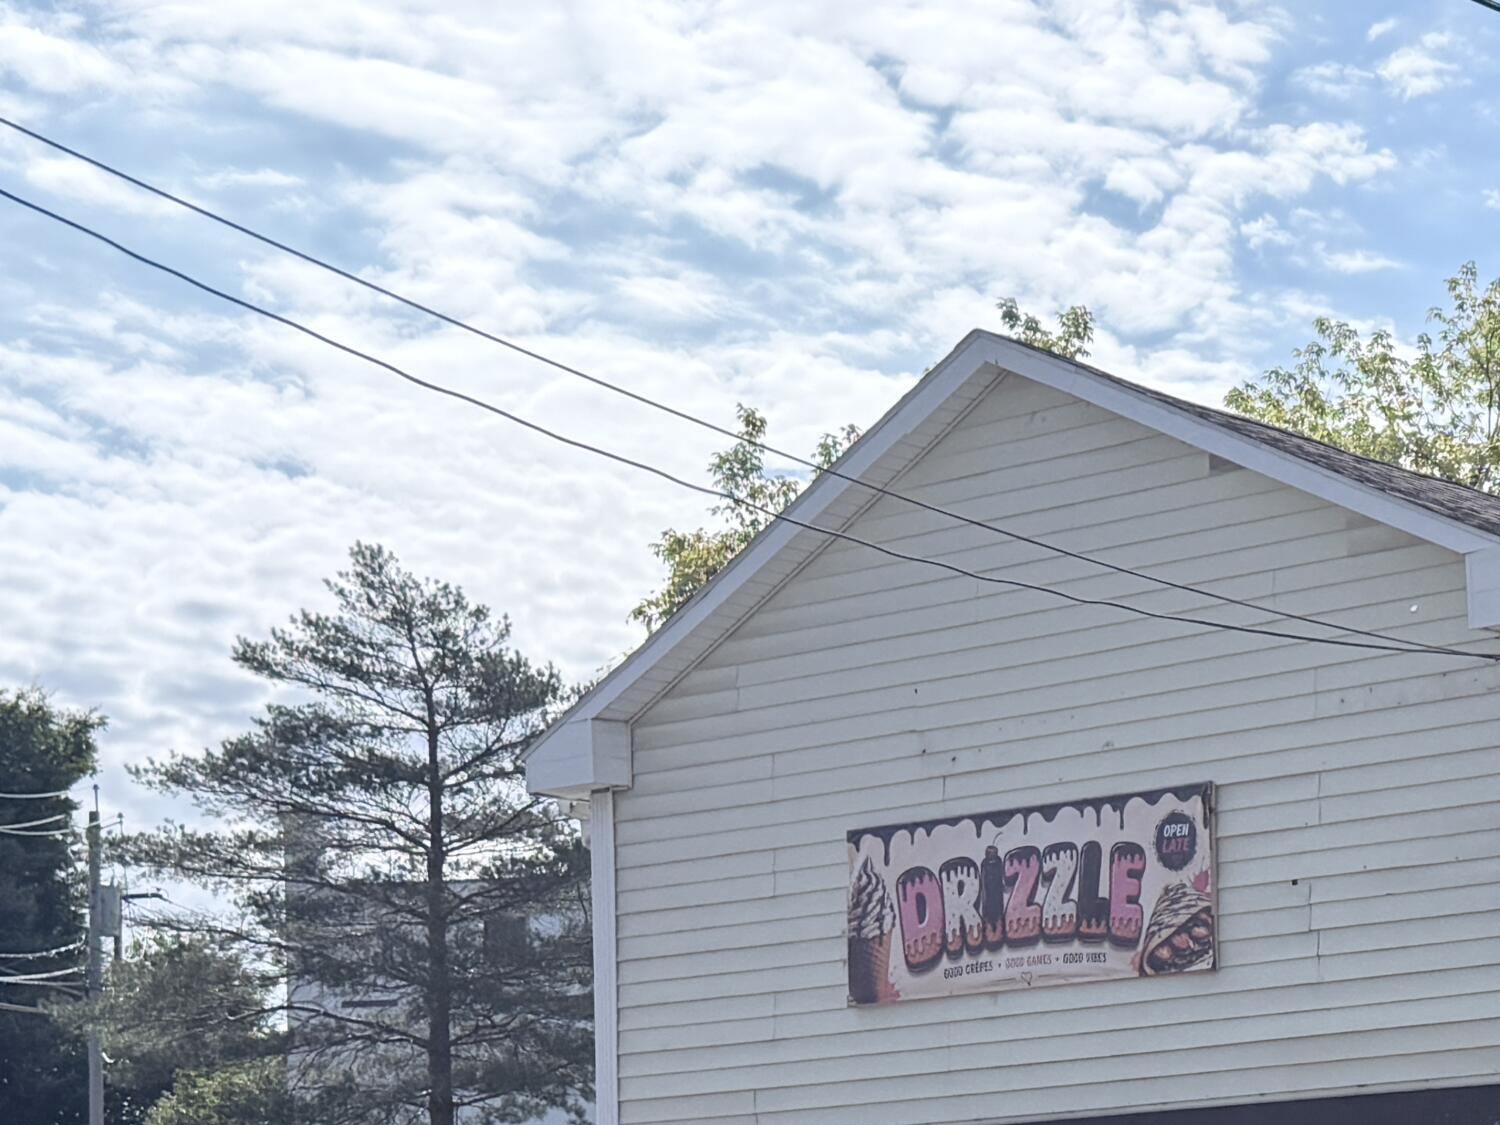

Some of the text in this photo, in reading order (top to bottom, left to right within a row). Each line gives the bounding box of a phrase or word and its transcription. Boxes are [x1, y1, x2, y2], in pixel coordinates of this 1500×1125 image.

[1163, 823, 1190, 838] OPEN
[1162, 838, 1190, 853] LATE
[895, 841, 1146, 973] DRIZZLE
[1062, 952, 1084, 964] GOOD
